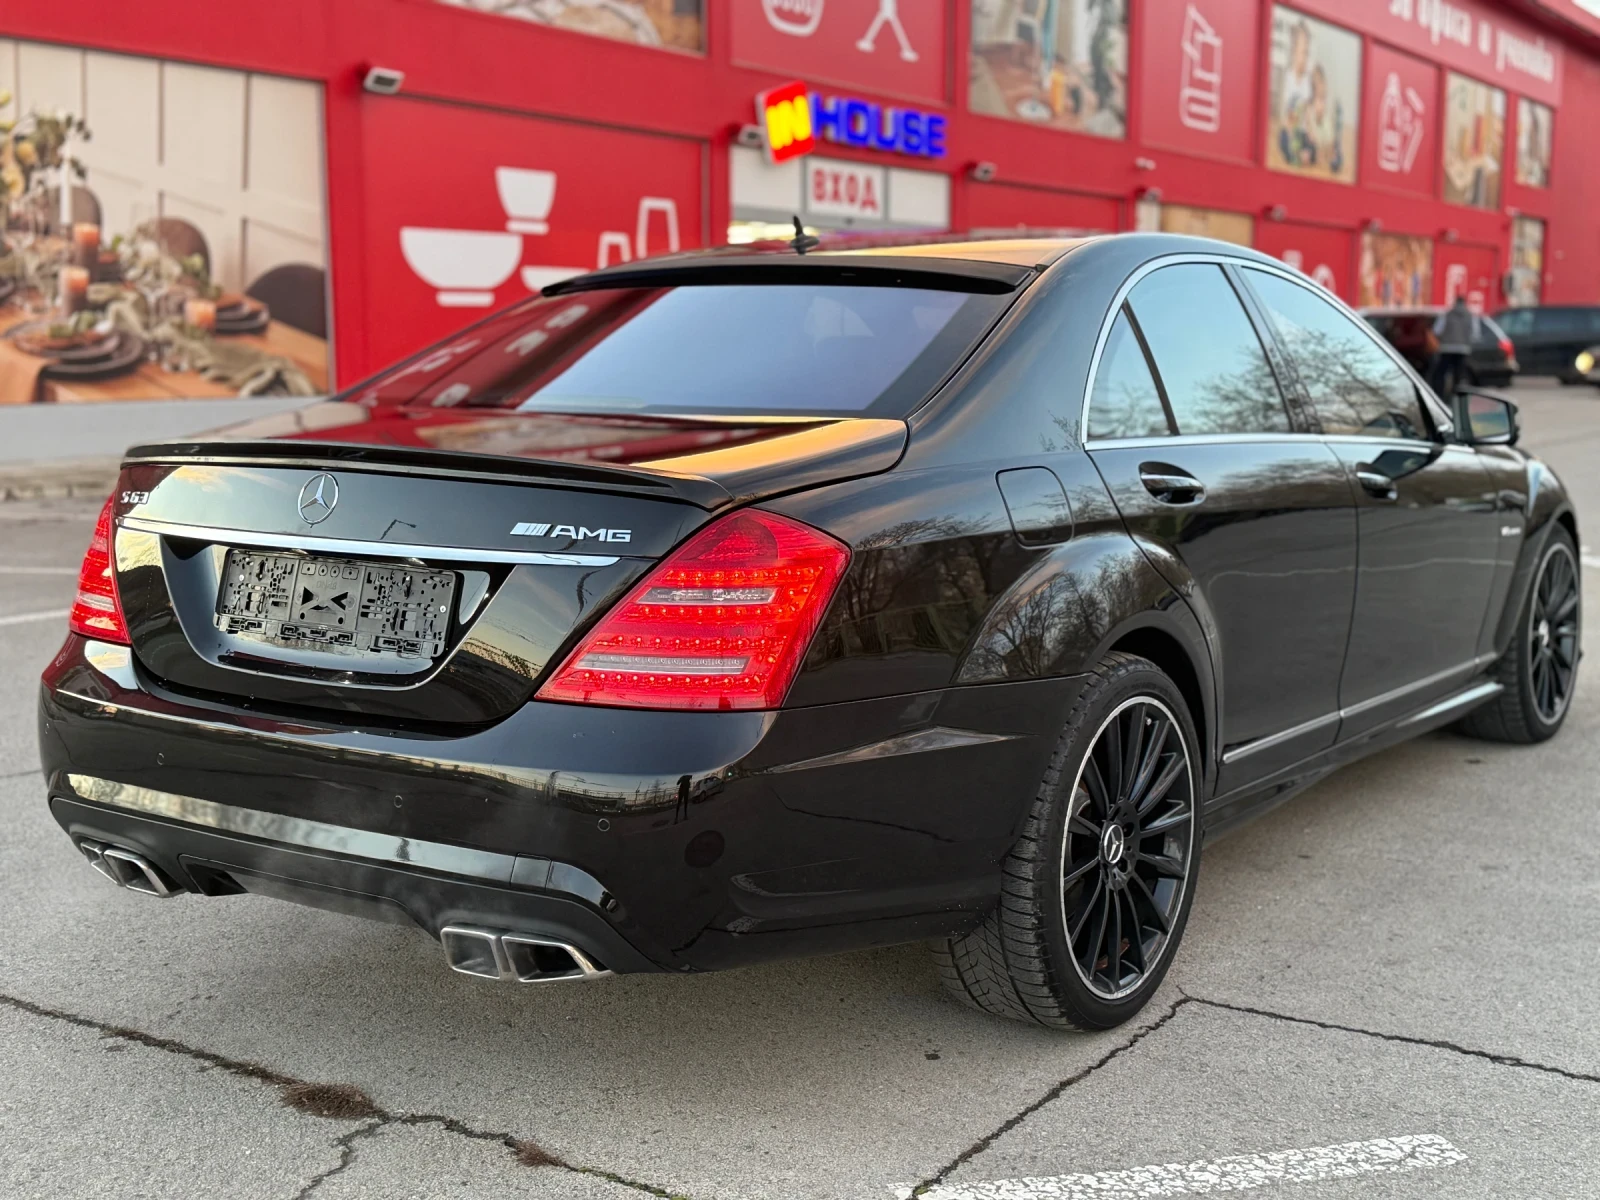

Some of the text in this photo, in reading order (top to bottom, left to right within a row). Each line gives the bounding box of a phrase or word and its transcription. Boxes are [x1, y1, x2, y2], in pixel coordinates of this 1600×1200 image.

[766, 91, 948, 158] IN HOUSE
[120, 490, 149, 505] S63
[550, 524, 632, 544] AMG
